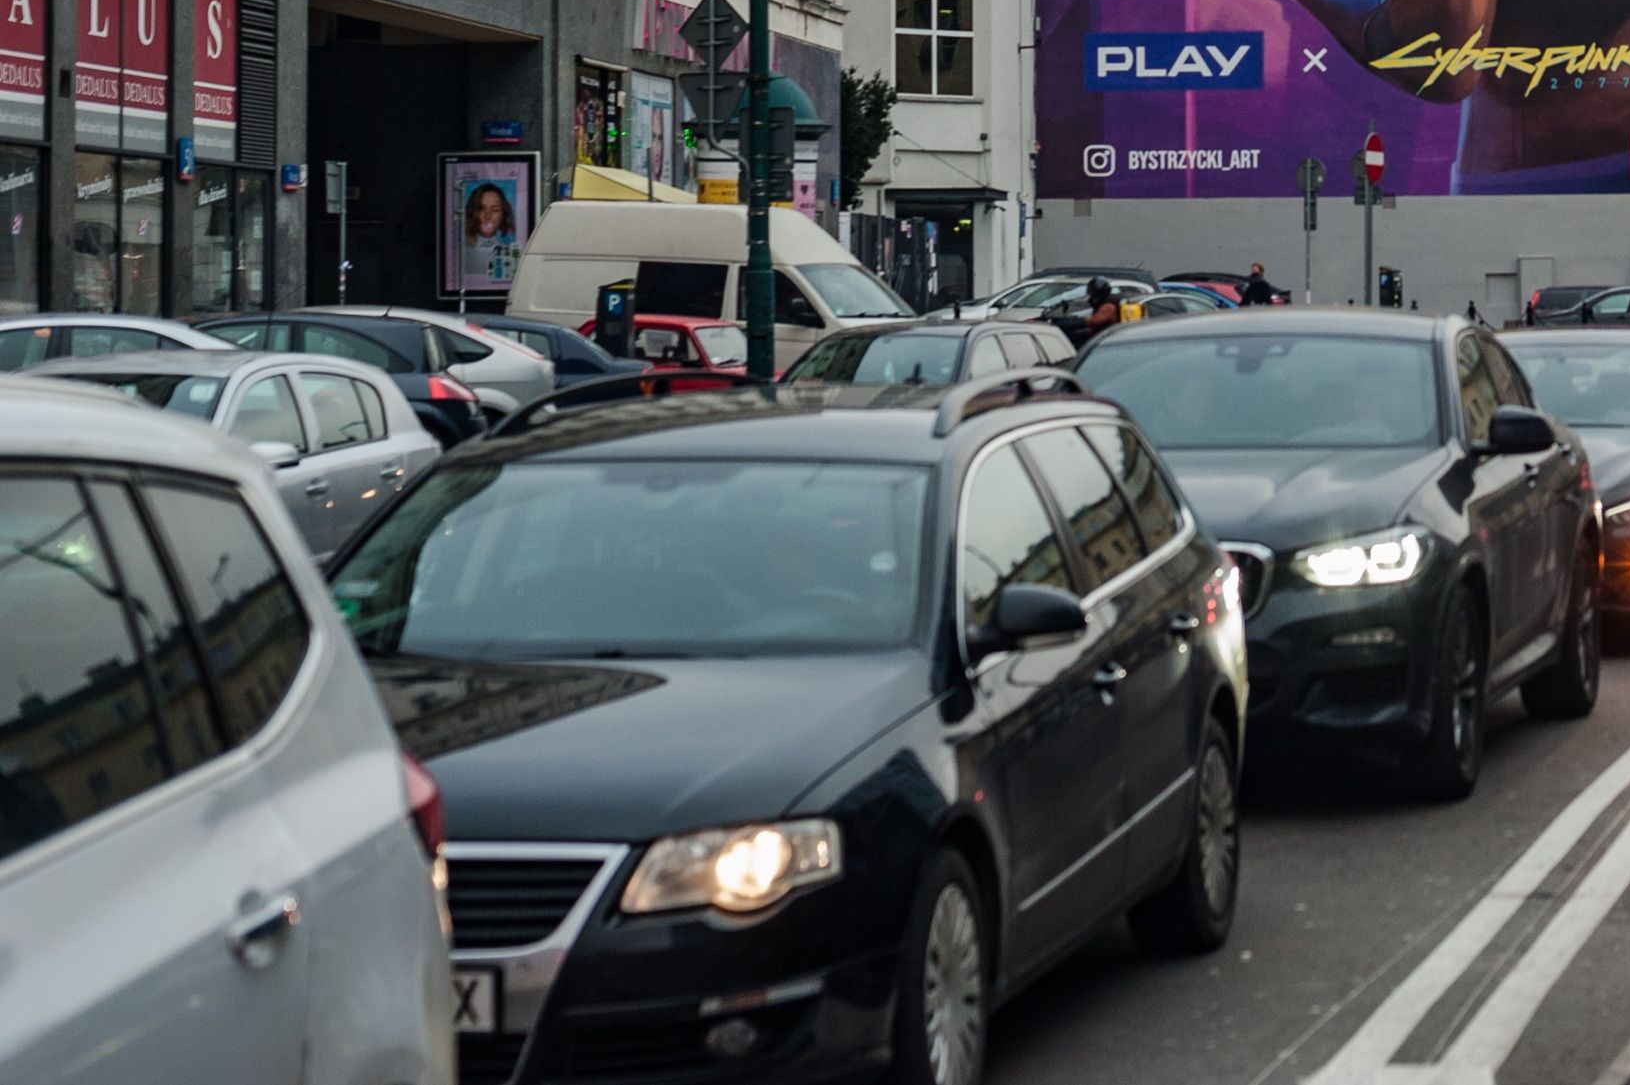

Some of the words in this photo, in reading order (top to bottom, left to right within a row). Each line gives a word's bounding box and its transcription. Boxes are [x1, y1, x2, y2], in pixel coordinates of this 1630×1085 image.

[1097, 45, 1250, 77] PLAY
[76, 74, 119, 99] DEDALUS
[124, 81, 165, 106] DEDALUS
[1550, 77, 1630, 89] 2077
[195, 92, 233, 115] DEDALUS
[1128, 149, 1261, 171] BYSTRZYCKI_ART
[608, 294, 621, 311] P
